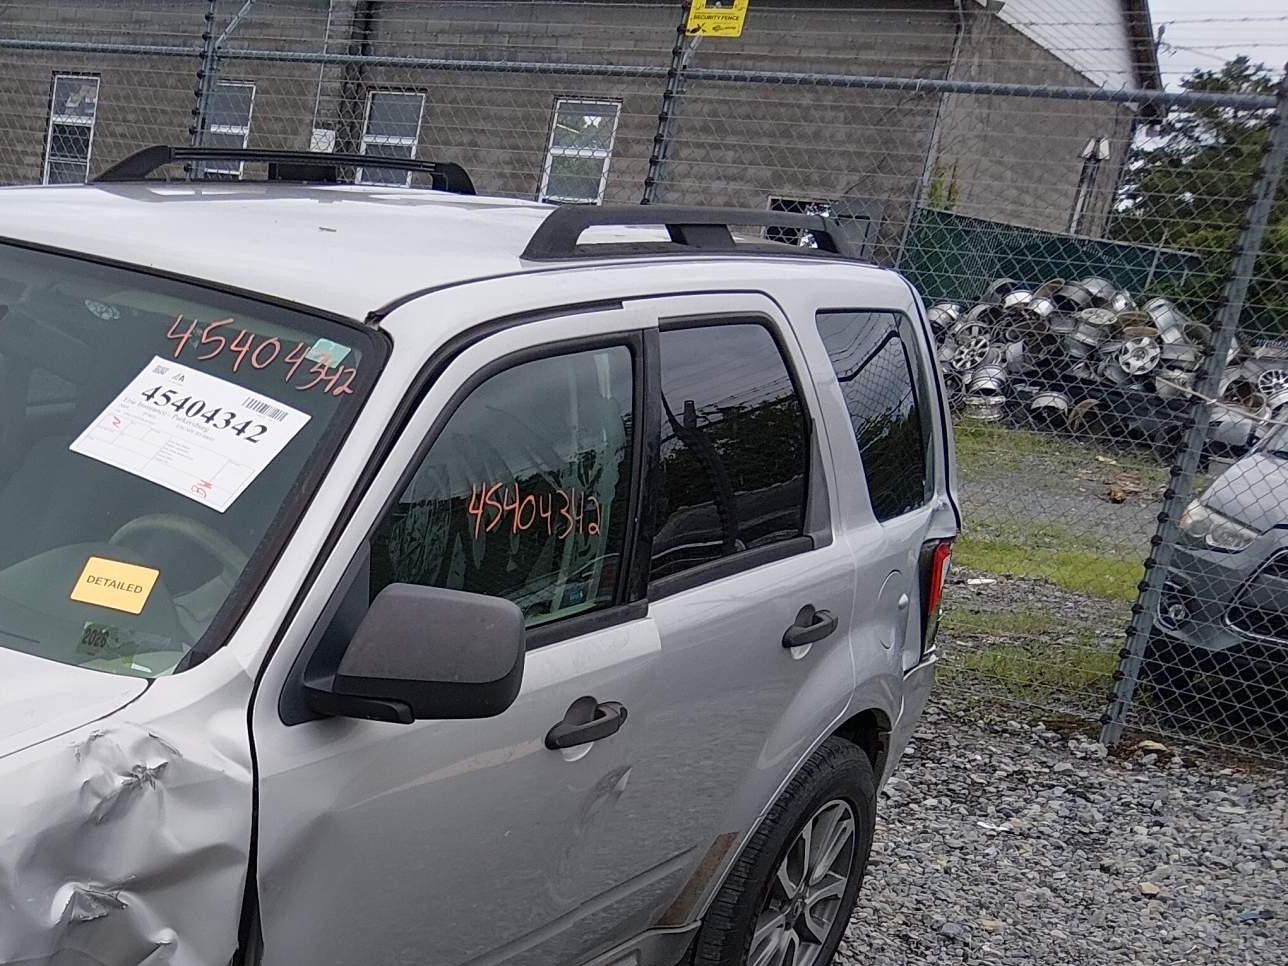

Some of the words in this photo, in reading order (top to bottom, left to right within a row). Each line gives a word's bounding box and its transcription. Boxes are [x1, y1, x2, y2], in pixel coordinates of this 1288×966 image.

[167, 313, 357, 395] 45404342
[141, 385, 268, 444] 45404342
[468, 482, 601, 540] 45404342
[86, 575, 143, 593] DETAILED
